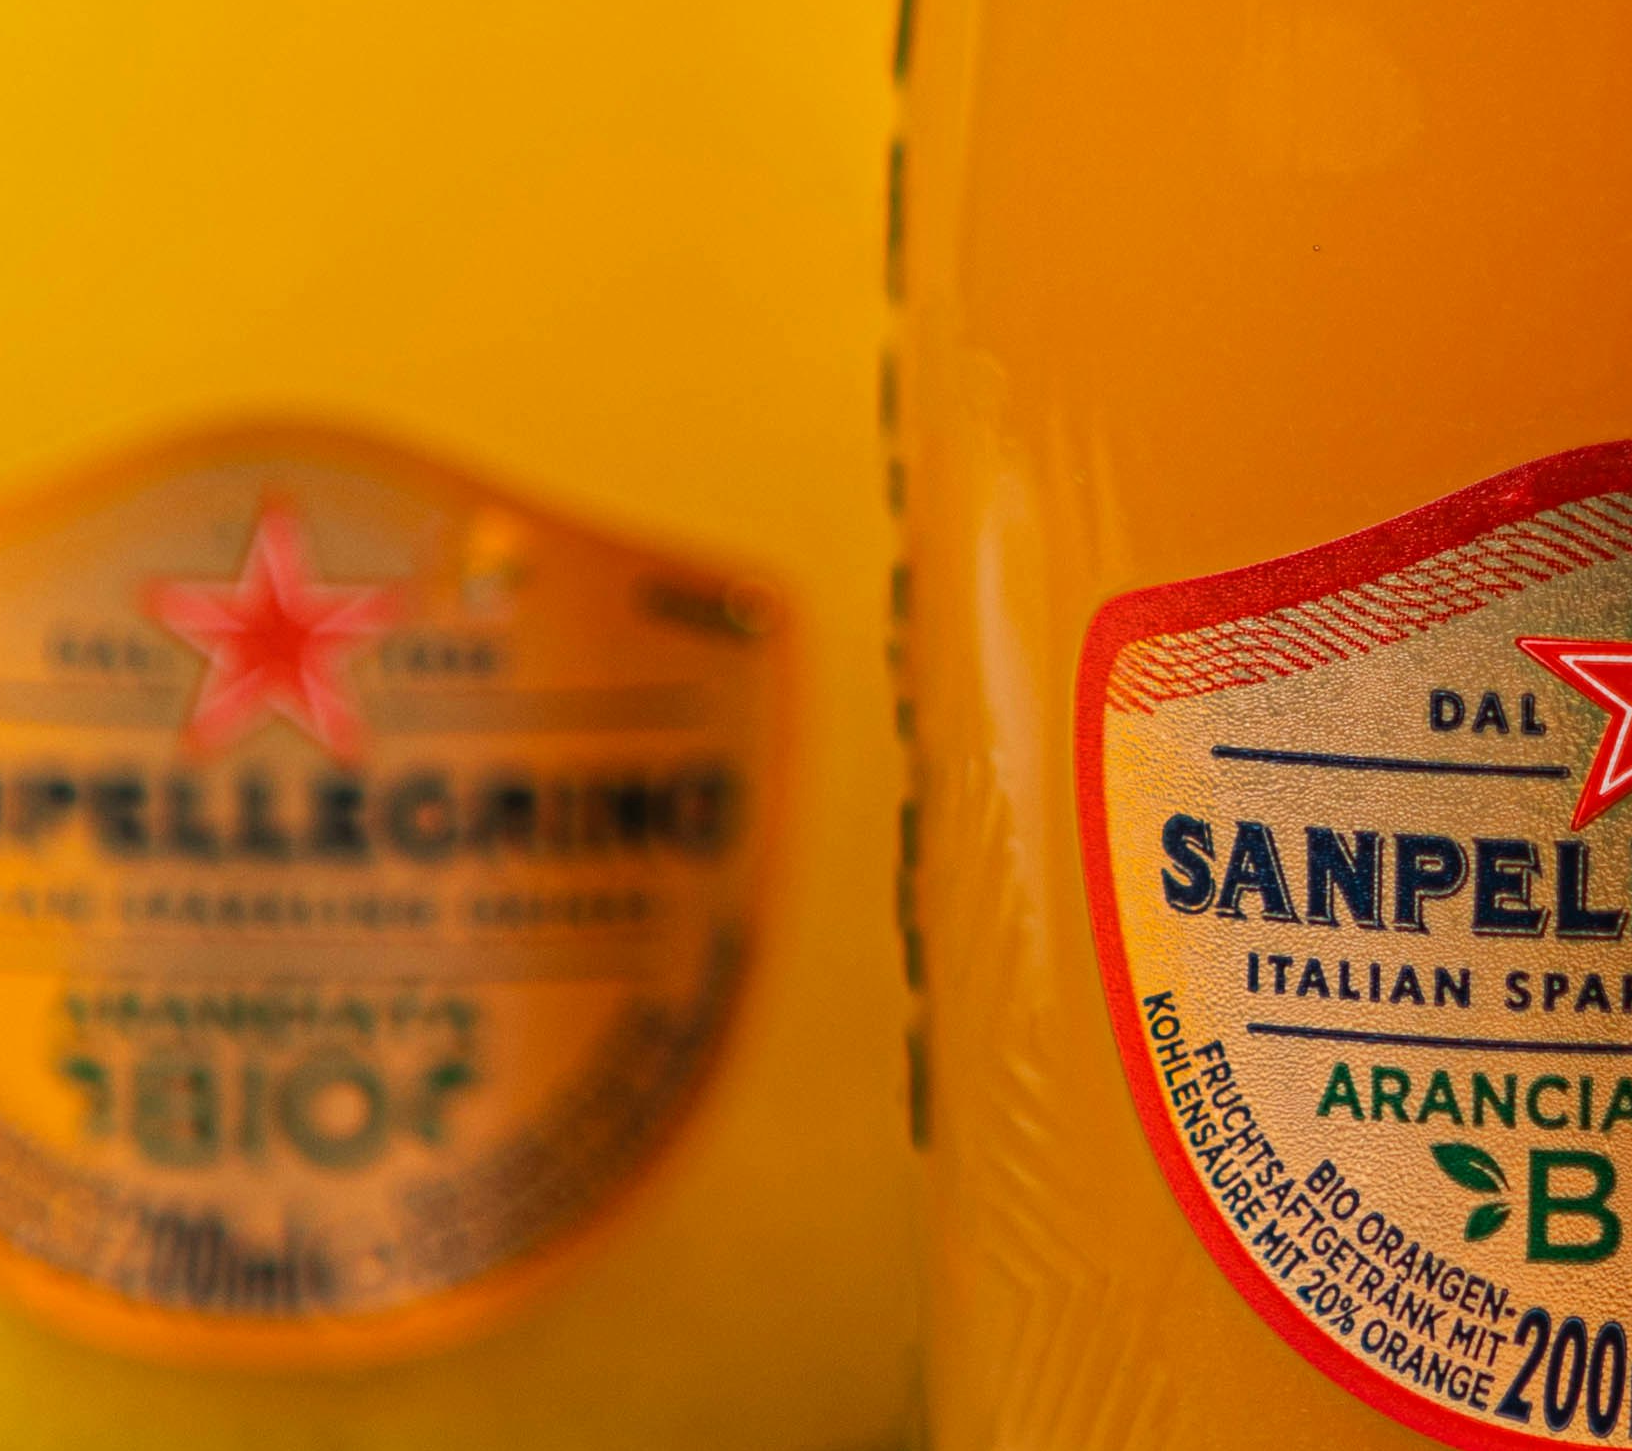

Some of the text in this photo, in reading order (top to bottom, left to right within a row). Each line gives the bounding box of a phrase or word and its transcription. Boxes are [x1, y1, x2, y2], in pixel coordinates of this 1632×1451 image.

[1430, 689, 1547, 735] DAL
[1246, 951, 1471, 1007] ITALIAN
[1143, 990, 1496, 1411] KOHLENSÄURE MIT 20% ORANGE
[1193, 1039, 1508, 1368] FRUCHTSAFTGETRÄNK MIT
[1304, 1159, 1517, 1324] BIO ORANGEN-
